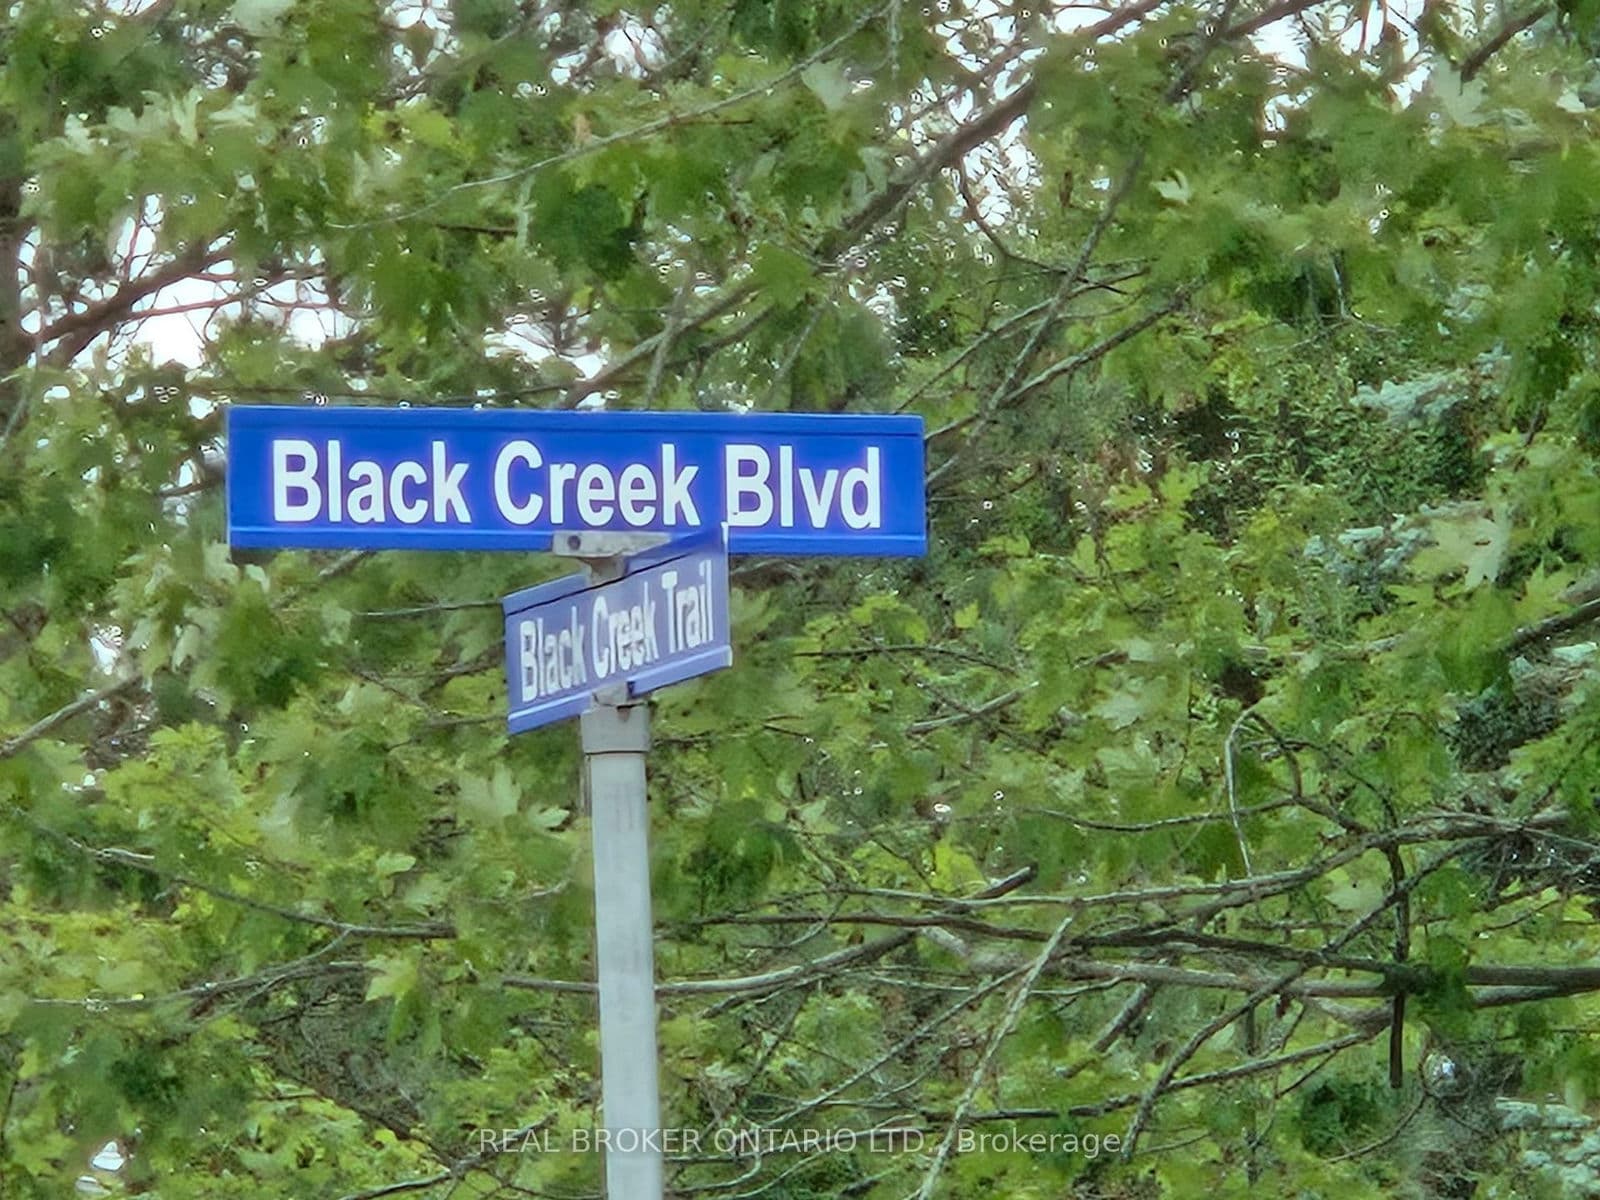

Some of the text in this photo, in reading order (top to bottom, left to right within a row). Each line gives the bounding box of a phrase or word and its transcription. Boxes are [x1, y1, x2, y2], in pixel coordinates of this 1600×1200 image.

[272, 439, 881, 530] Black Creek Blvd
[520, 559, 714, 702] Black Creek Trail
